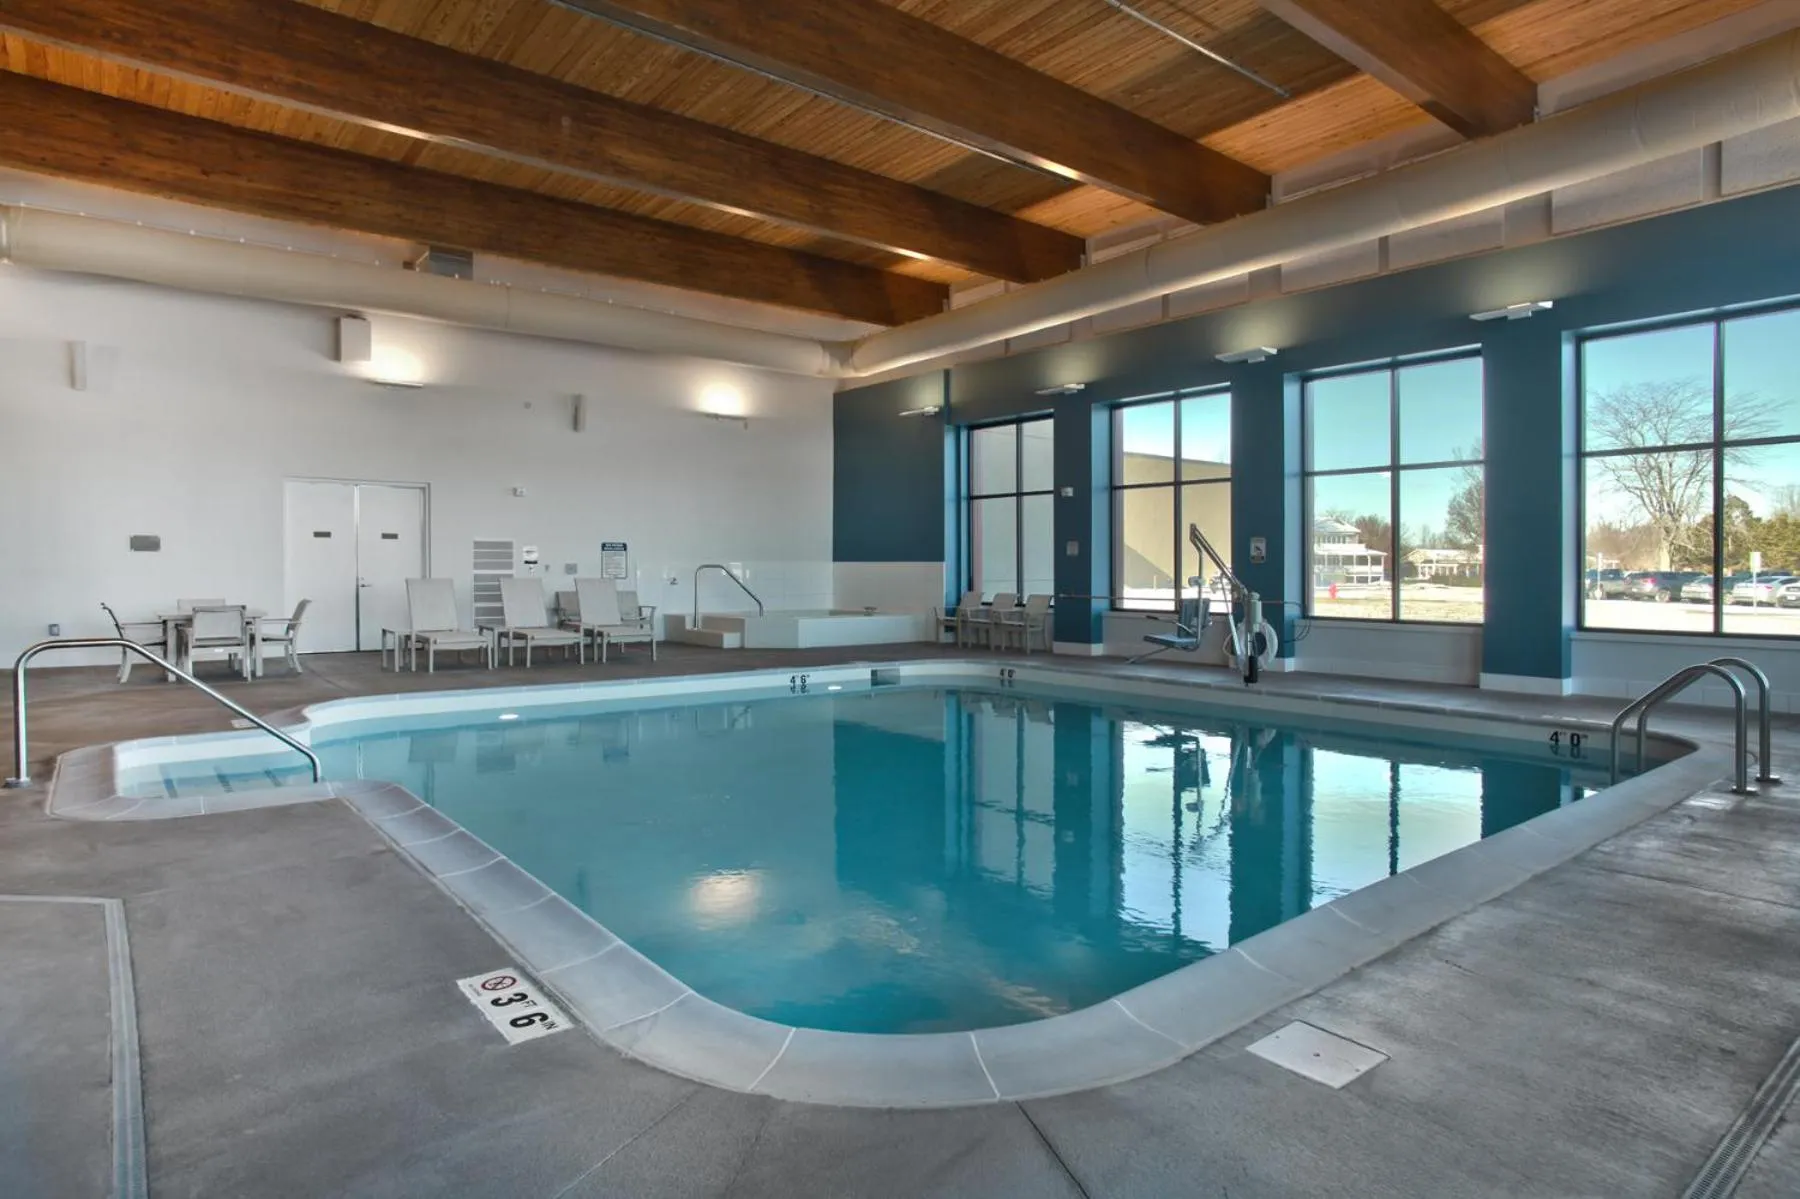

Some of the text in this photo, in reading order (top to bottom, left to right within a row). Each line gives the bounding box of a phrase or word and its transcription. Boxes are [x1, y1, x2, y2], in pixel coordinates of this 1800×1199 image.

[1549, 731, 1559, 745] 4
[490, 992, 528, 1007] 3
[509, 1012, 549, 1028] 6
